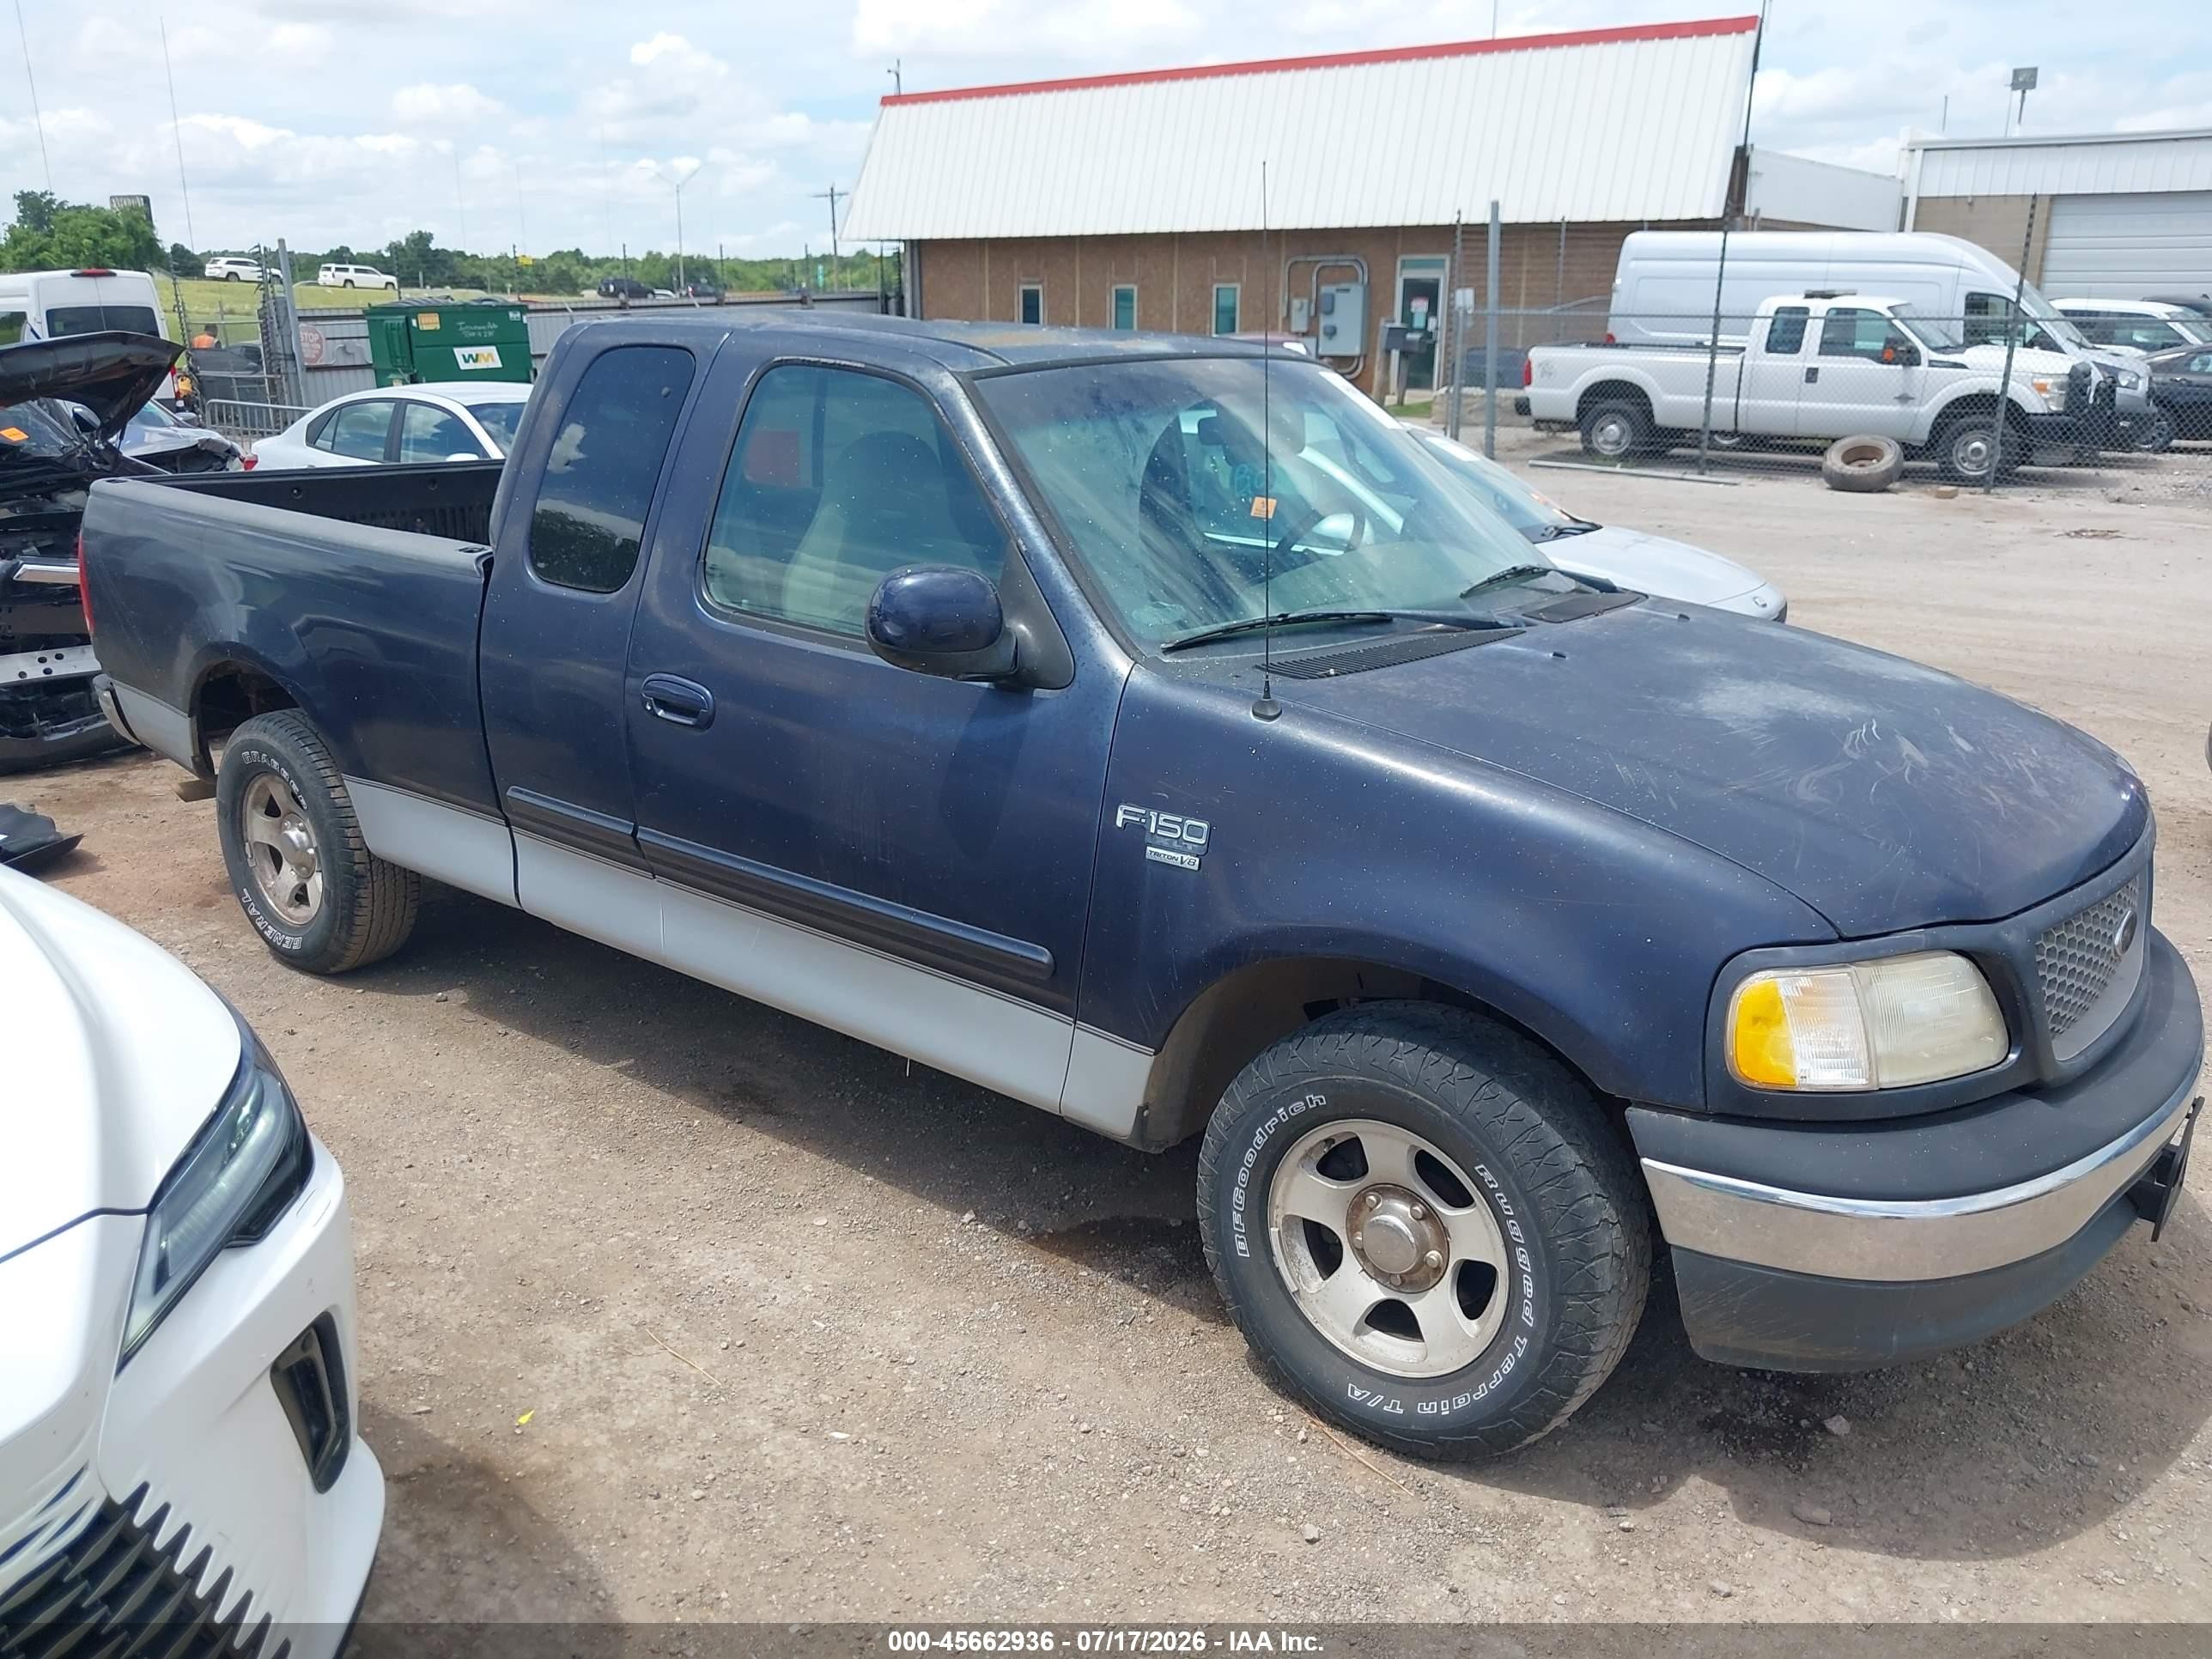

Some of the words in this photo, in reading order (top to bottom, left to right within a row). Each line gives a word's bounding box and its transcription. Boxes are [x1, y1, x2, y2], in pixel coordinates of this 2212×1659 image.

[462, 352, 495, 363] WM
[1115, 805, 1209, 845] F-150
[1149, 849, 1179, 861] TRITON
[1180, 855, 1197, 866] V8
[241, 887, 303, 950] GENERAL
[1232, 1094, 1328, 1258] BFGoodrich
[1474, 1164, 1534, 1328] Rugged
[1347, 1382, 1406, 1415] T/A
[1417, 1334, 1528, 1416] Terrain
